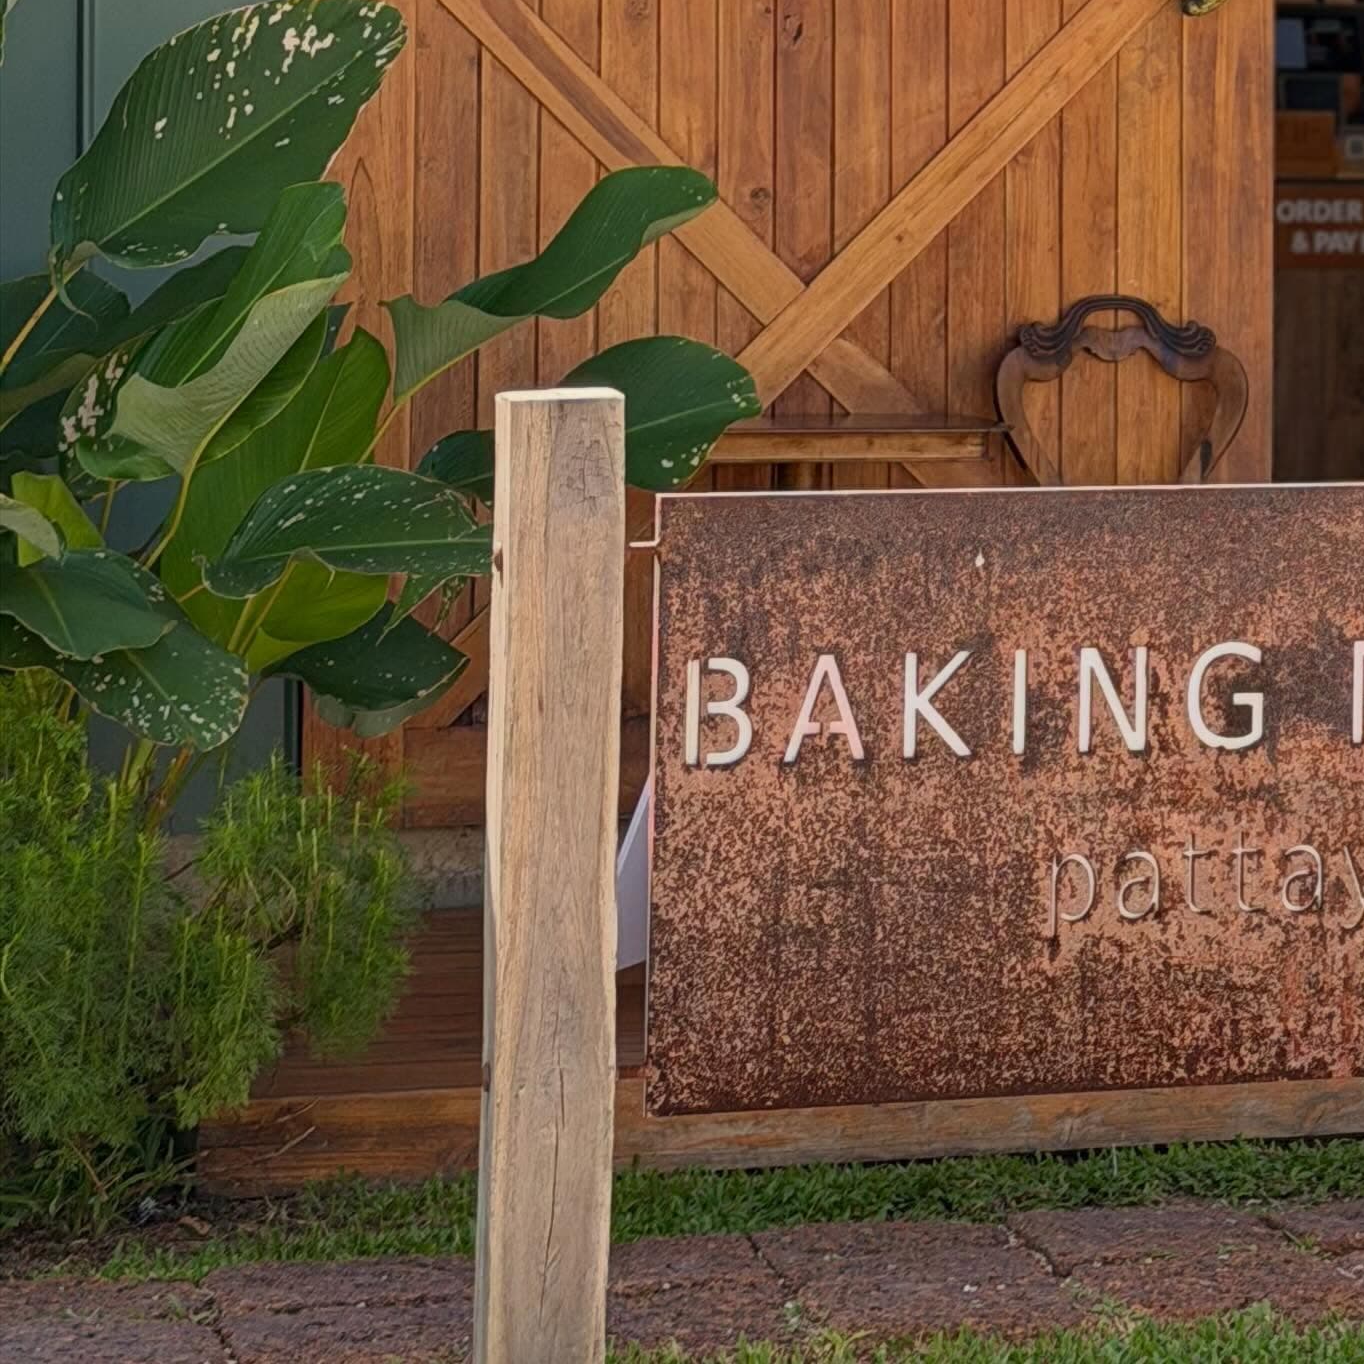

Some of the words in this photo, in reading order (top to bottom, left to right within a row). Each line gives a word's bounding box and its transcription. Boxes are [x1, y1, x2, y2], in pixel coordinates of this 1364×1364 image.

[1276, 199, 1364, 223] ORDER
[1314, 231, 1359, 254] PAY
[685, 641, 1265, 766] BAKING
